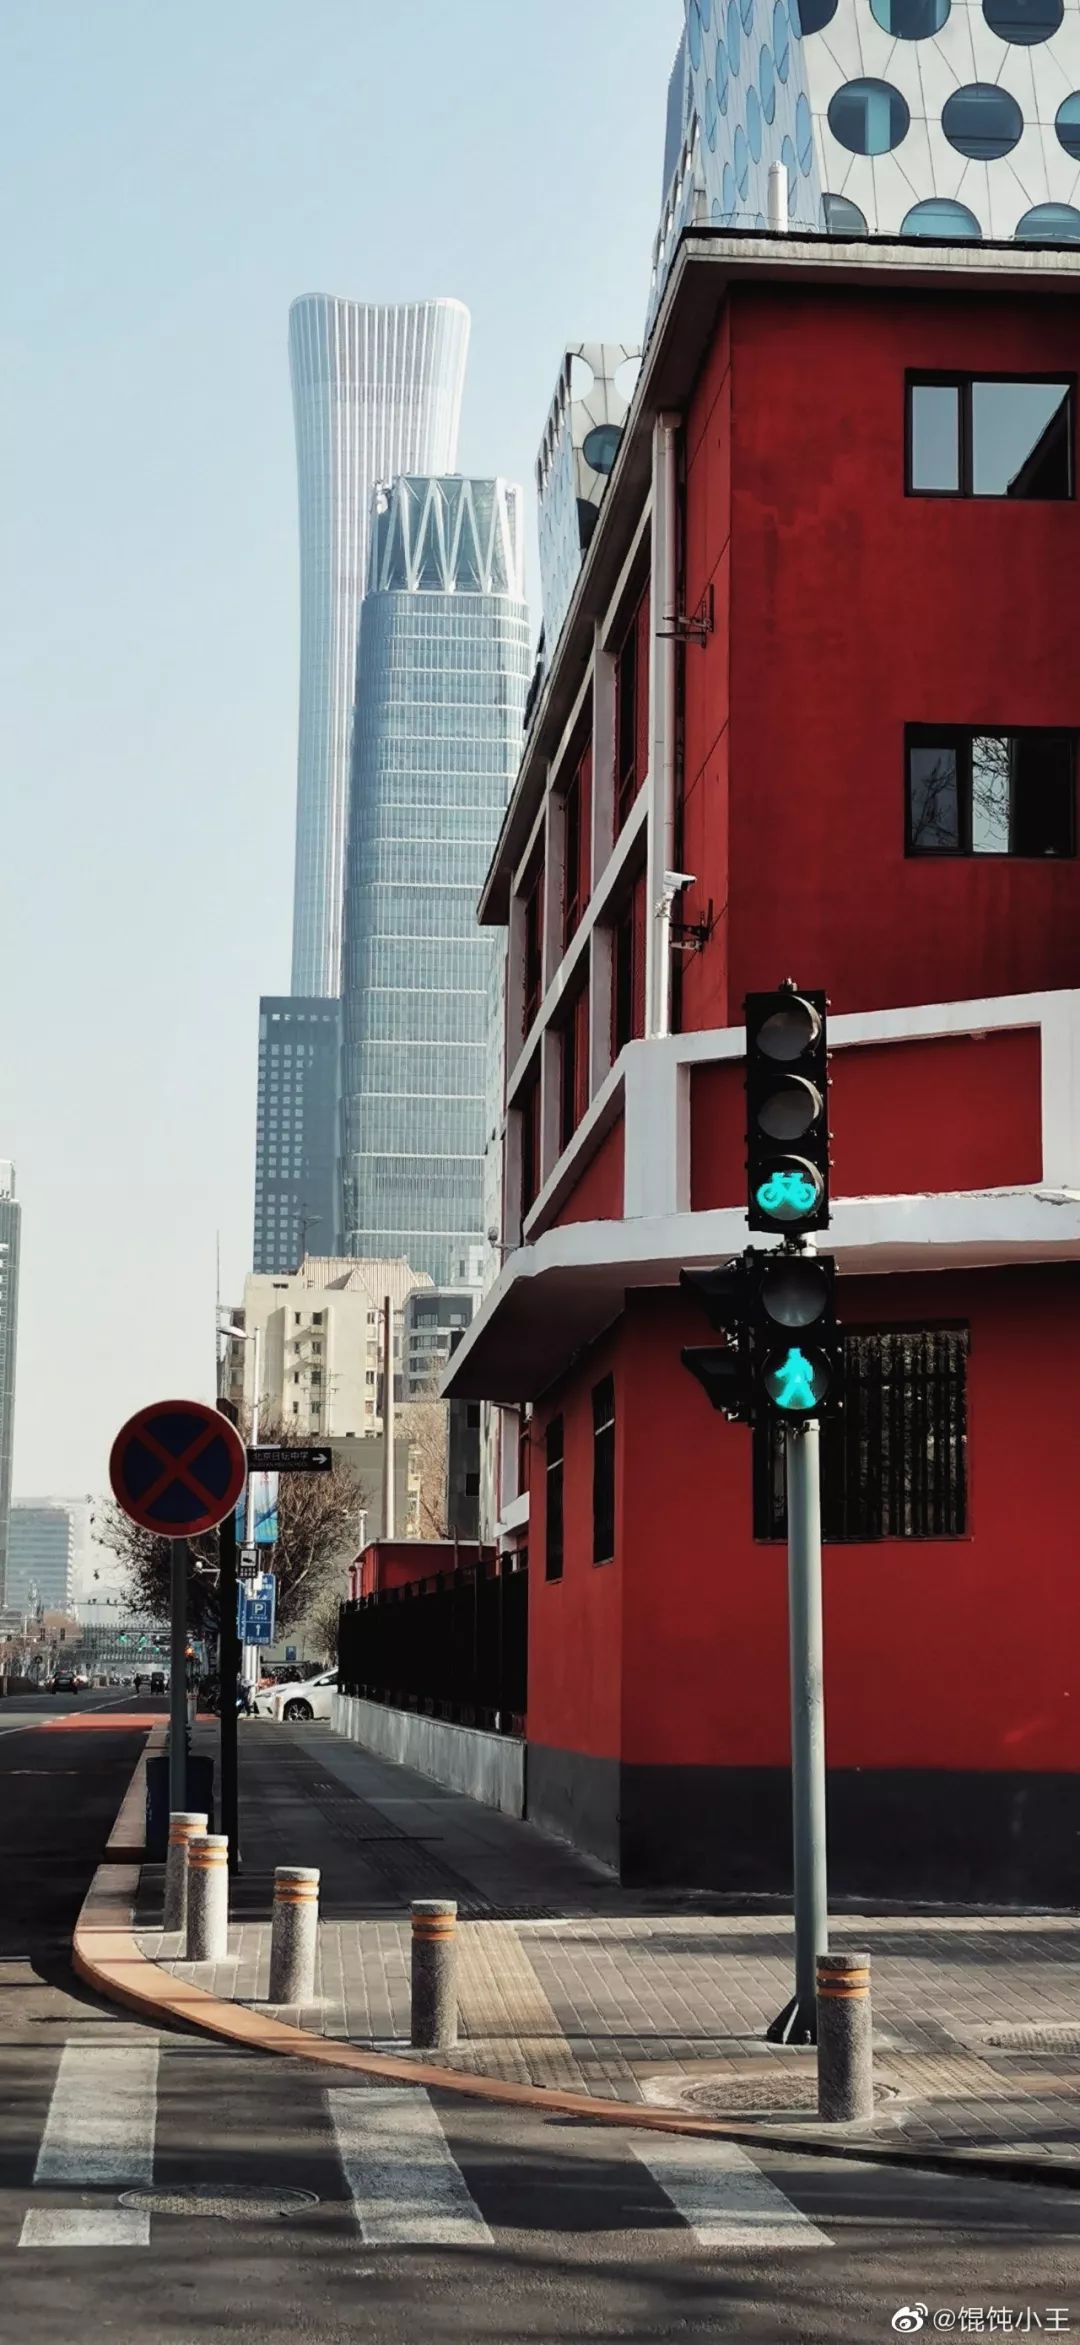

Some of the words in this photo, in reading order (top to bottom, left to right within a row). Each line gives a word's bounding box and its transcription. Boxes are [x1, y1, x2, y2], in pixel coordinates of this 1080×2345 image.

[253, 1451, 309, 1461] 北京日坛中学
[255, 1603, 264, 1615] P
